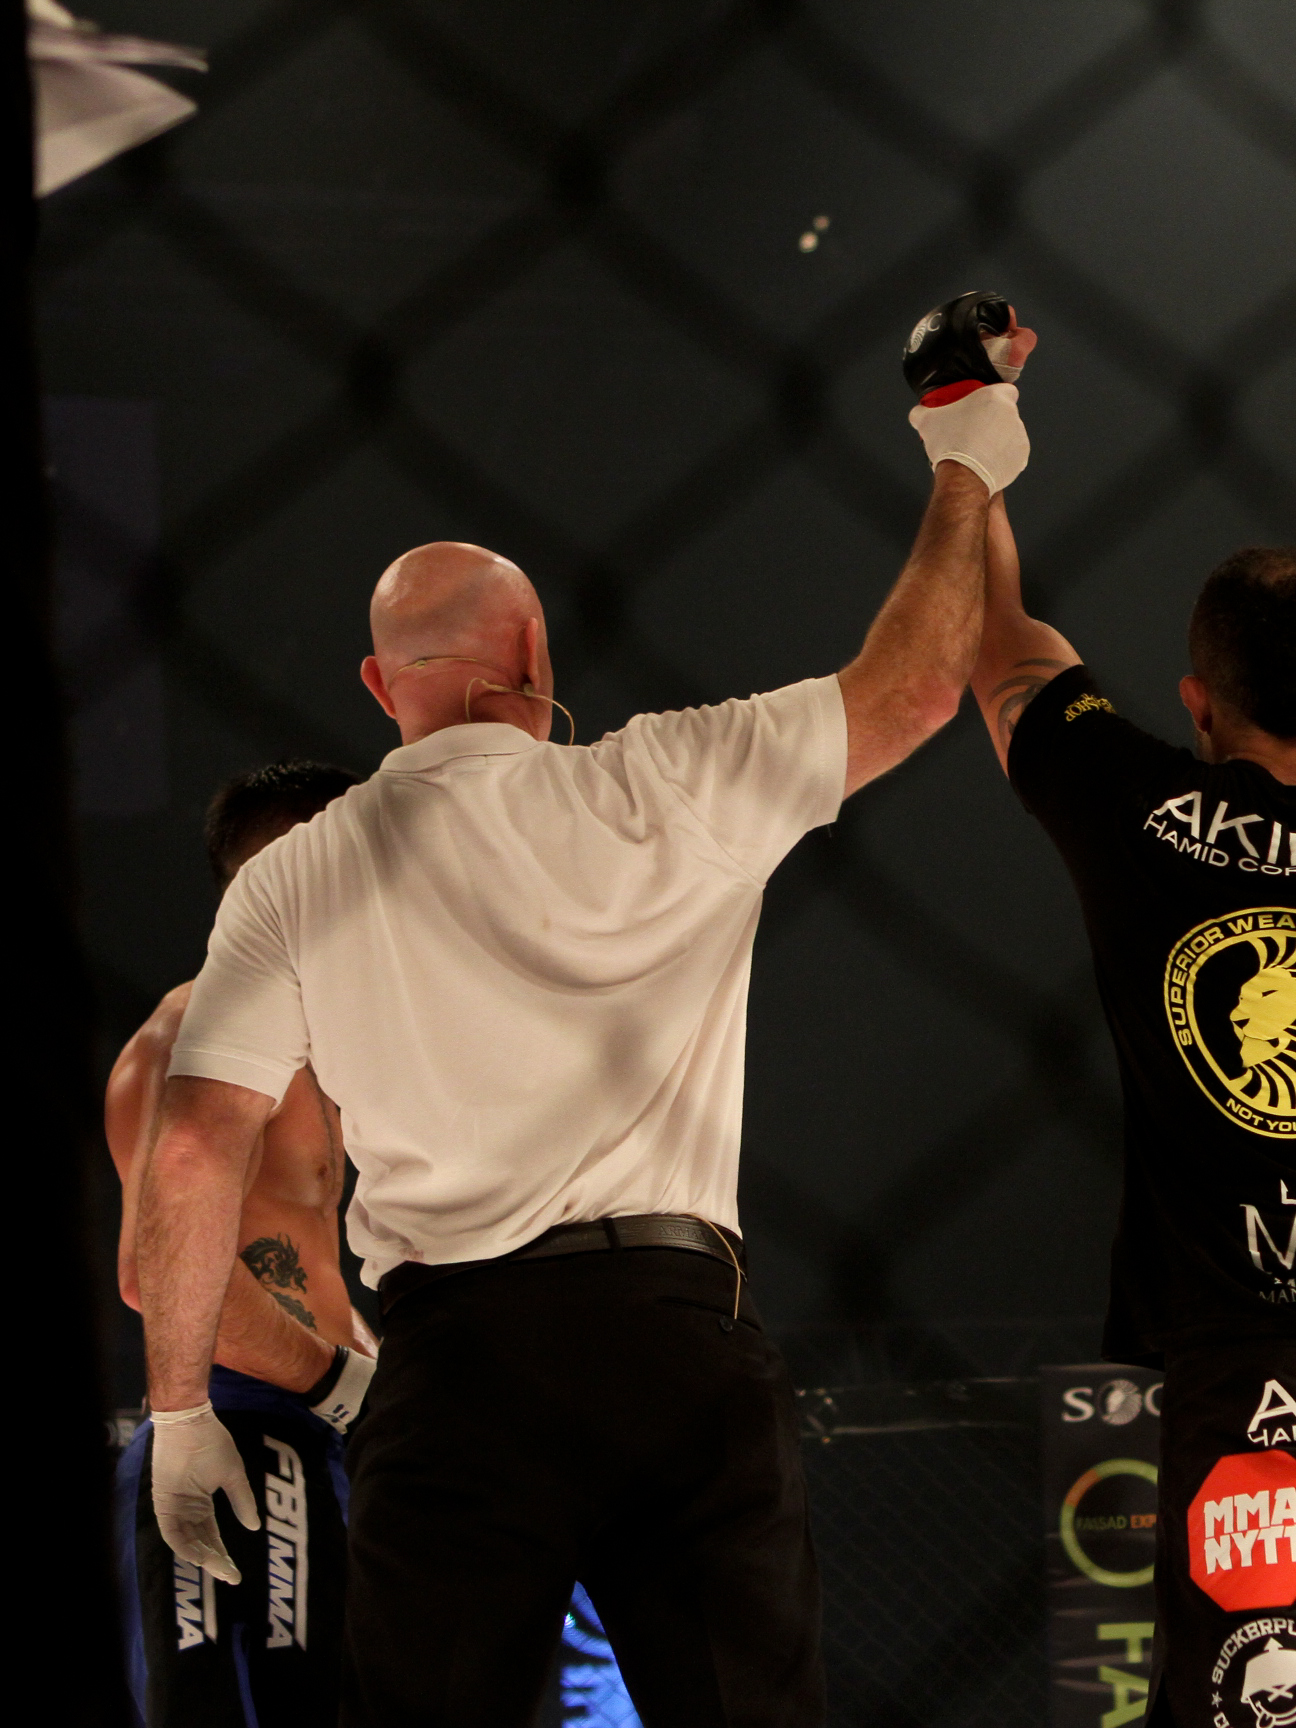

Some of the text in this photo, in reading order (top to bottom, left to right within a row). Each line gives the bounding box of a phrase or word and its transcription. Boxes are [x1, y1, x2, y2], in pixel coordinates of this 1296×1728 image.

[1143, 813, 1230, 868] HAMID
[1170, 926, 1225, 1046] SUPERIOR
[1225, 1097, 1266, 1126] NOT
